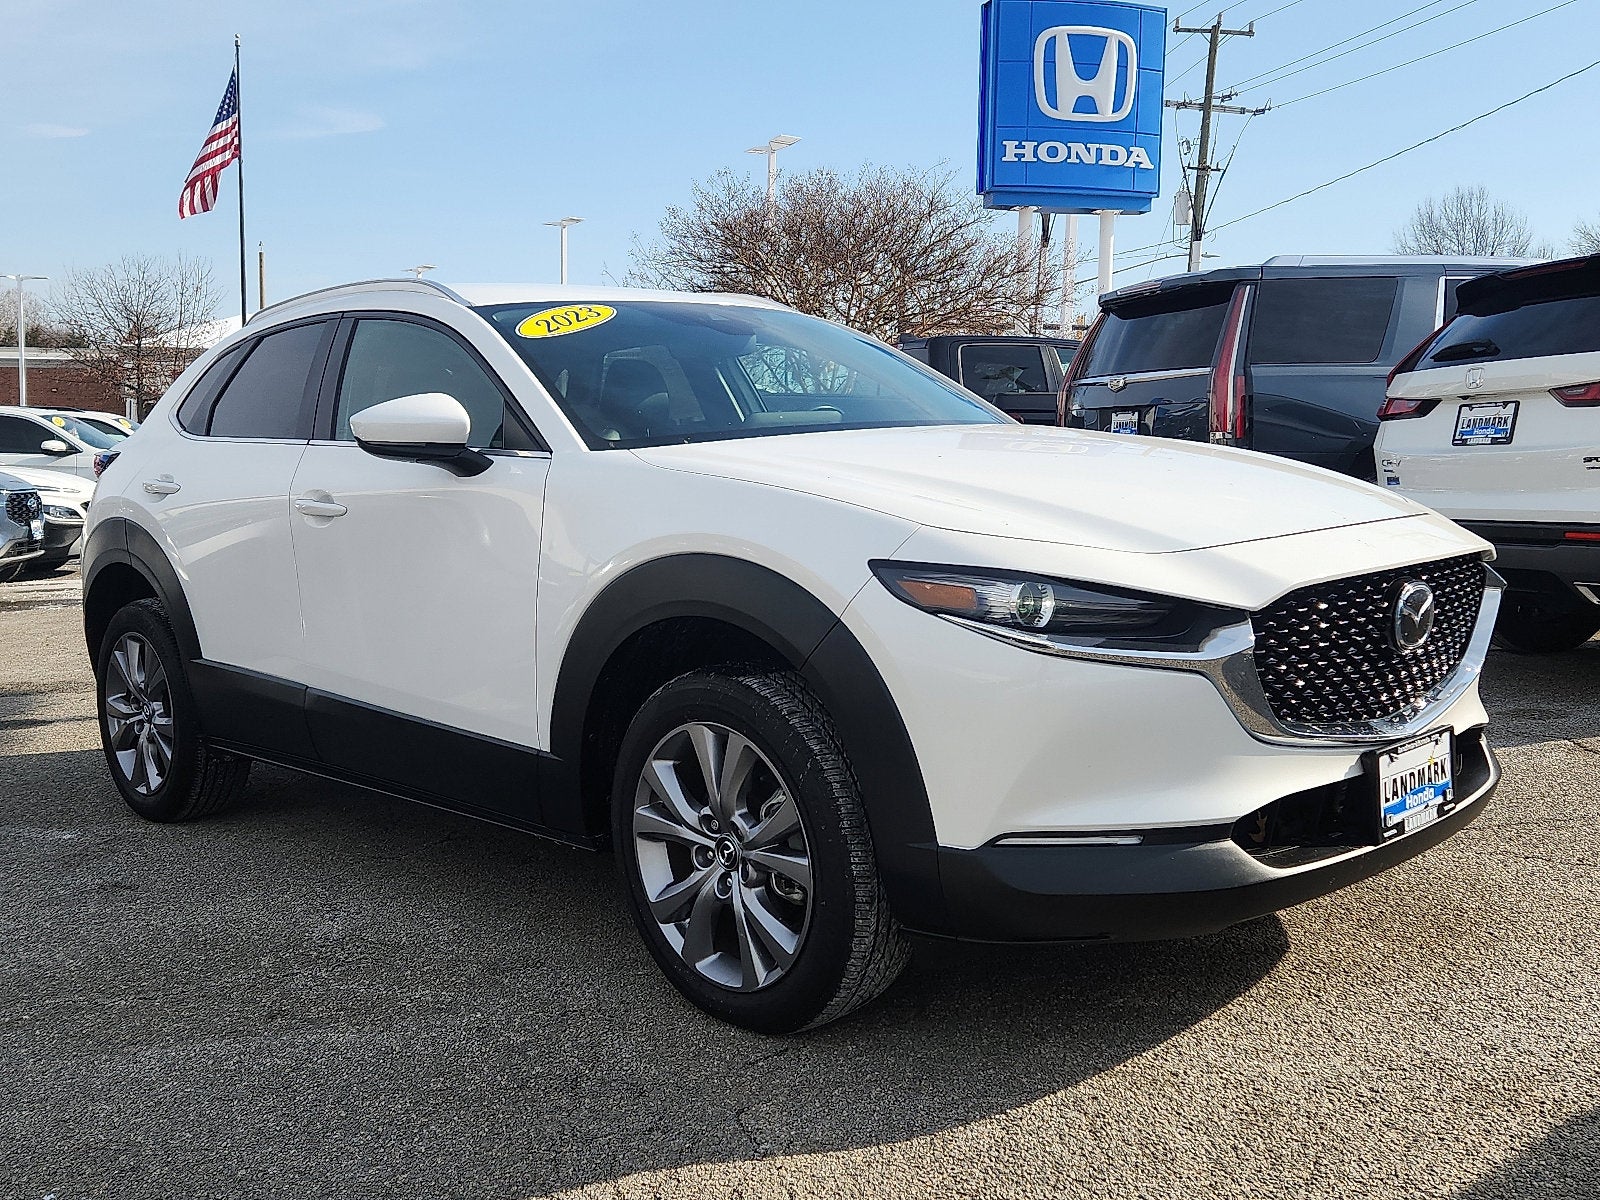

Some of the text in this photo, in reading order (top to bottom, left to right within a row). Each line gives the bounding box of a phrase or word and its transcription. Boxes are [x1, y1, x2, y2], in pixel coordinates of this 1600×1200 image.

[1001, 141, 1154, 169] HONDA
[535, 306, 602, 333] 2023
[1461, 415, 1510, 429] LANDMARK
[1473, 427, 1496, 435] Honda
[1384, 757, 1448, 804] LANDMARK
[1406, 787, 1435, 809] Honda
